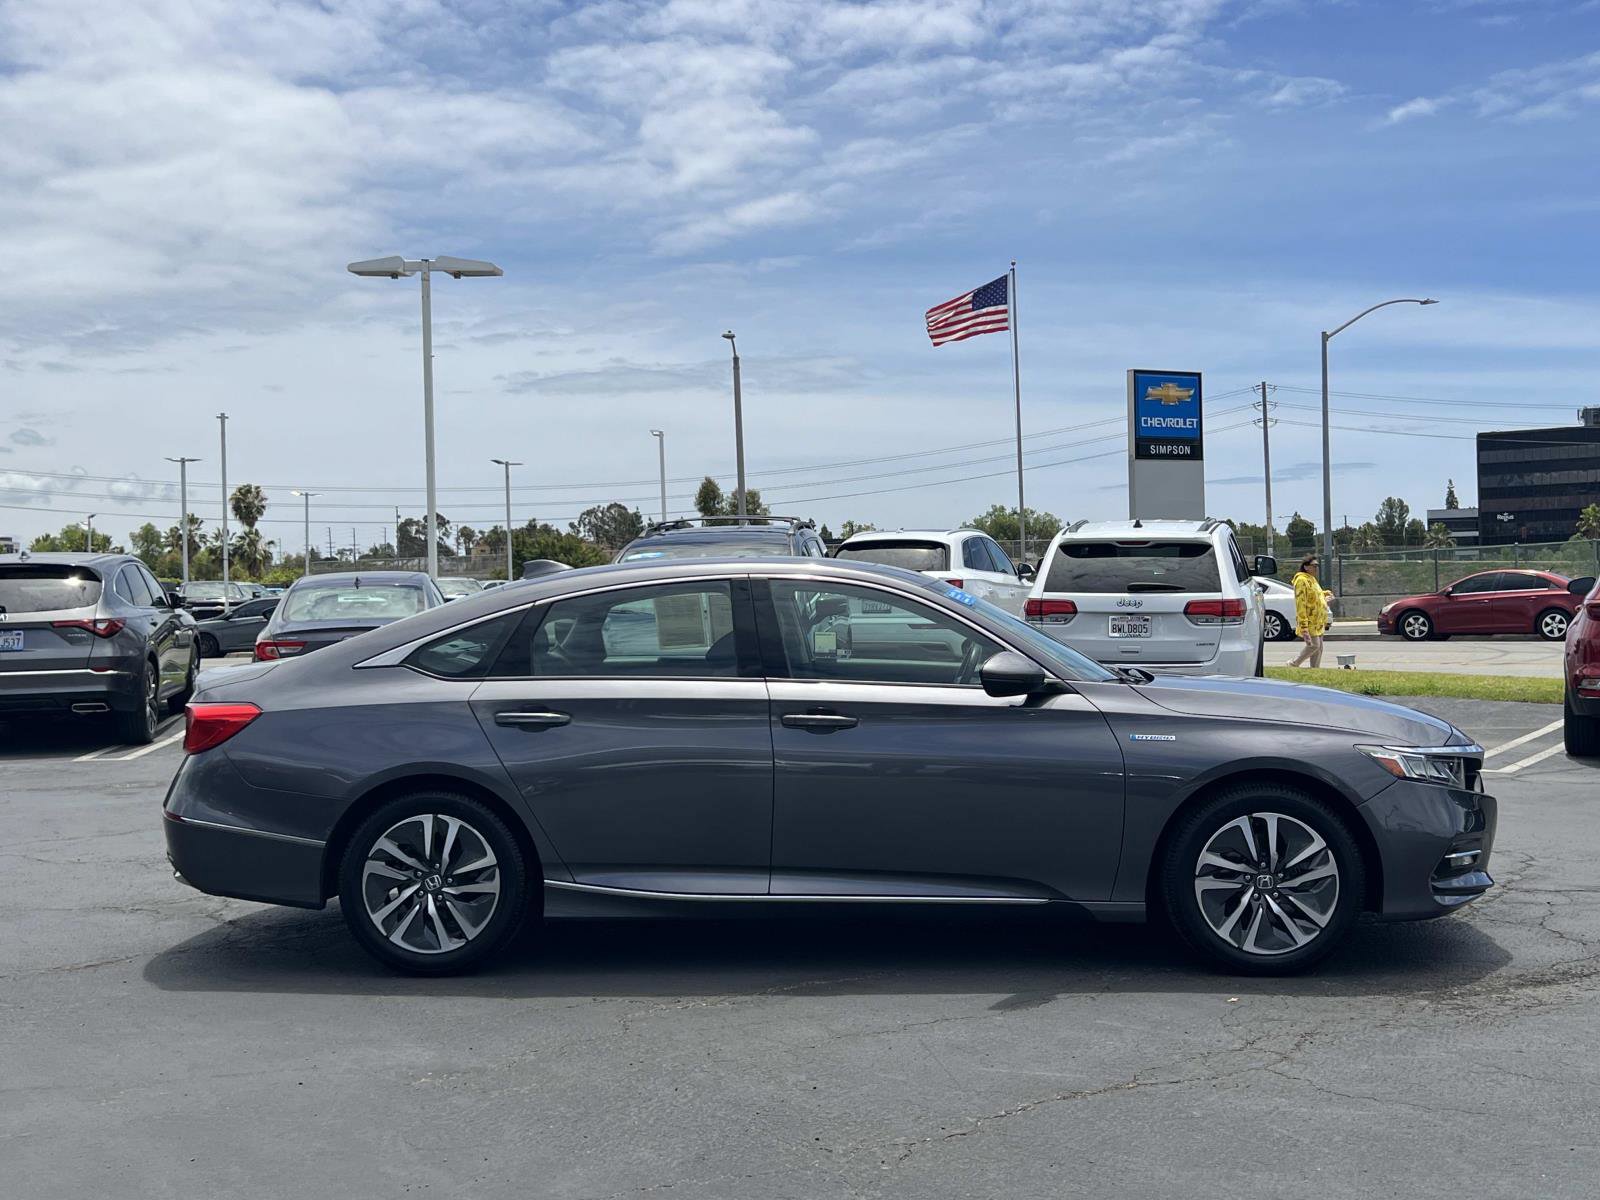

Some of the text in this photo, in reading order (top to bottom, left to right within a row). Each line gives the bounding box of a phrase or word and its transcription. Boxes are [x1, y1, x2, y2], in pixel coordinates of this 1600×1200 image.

[1141, 416, 1198, 428] CHEVROLET
[1150, 445, 1191, 455] SIMPSON
[1117, 598, 1143, 608] Jeep
[1112, 623, 1149, 634] 8WLD805
